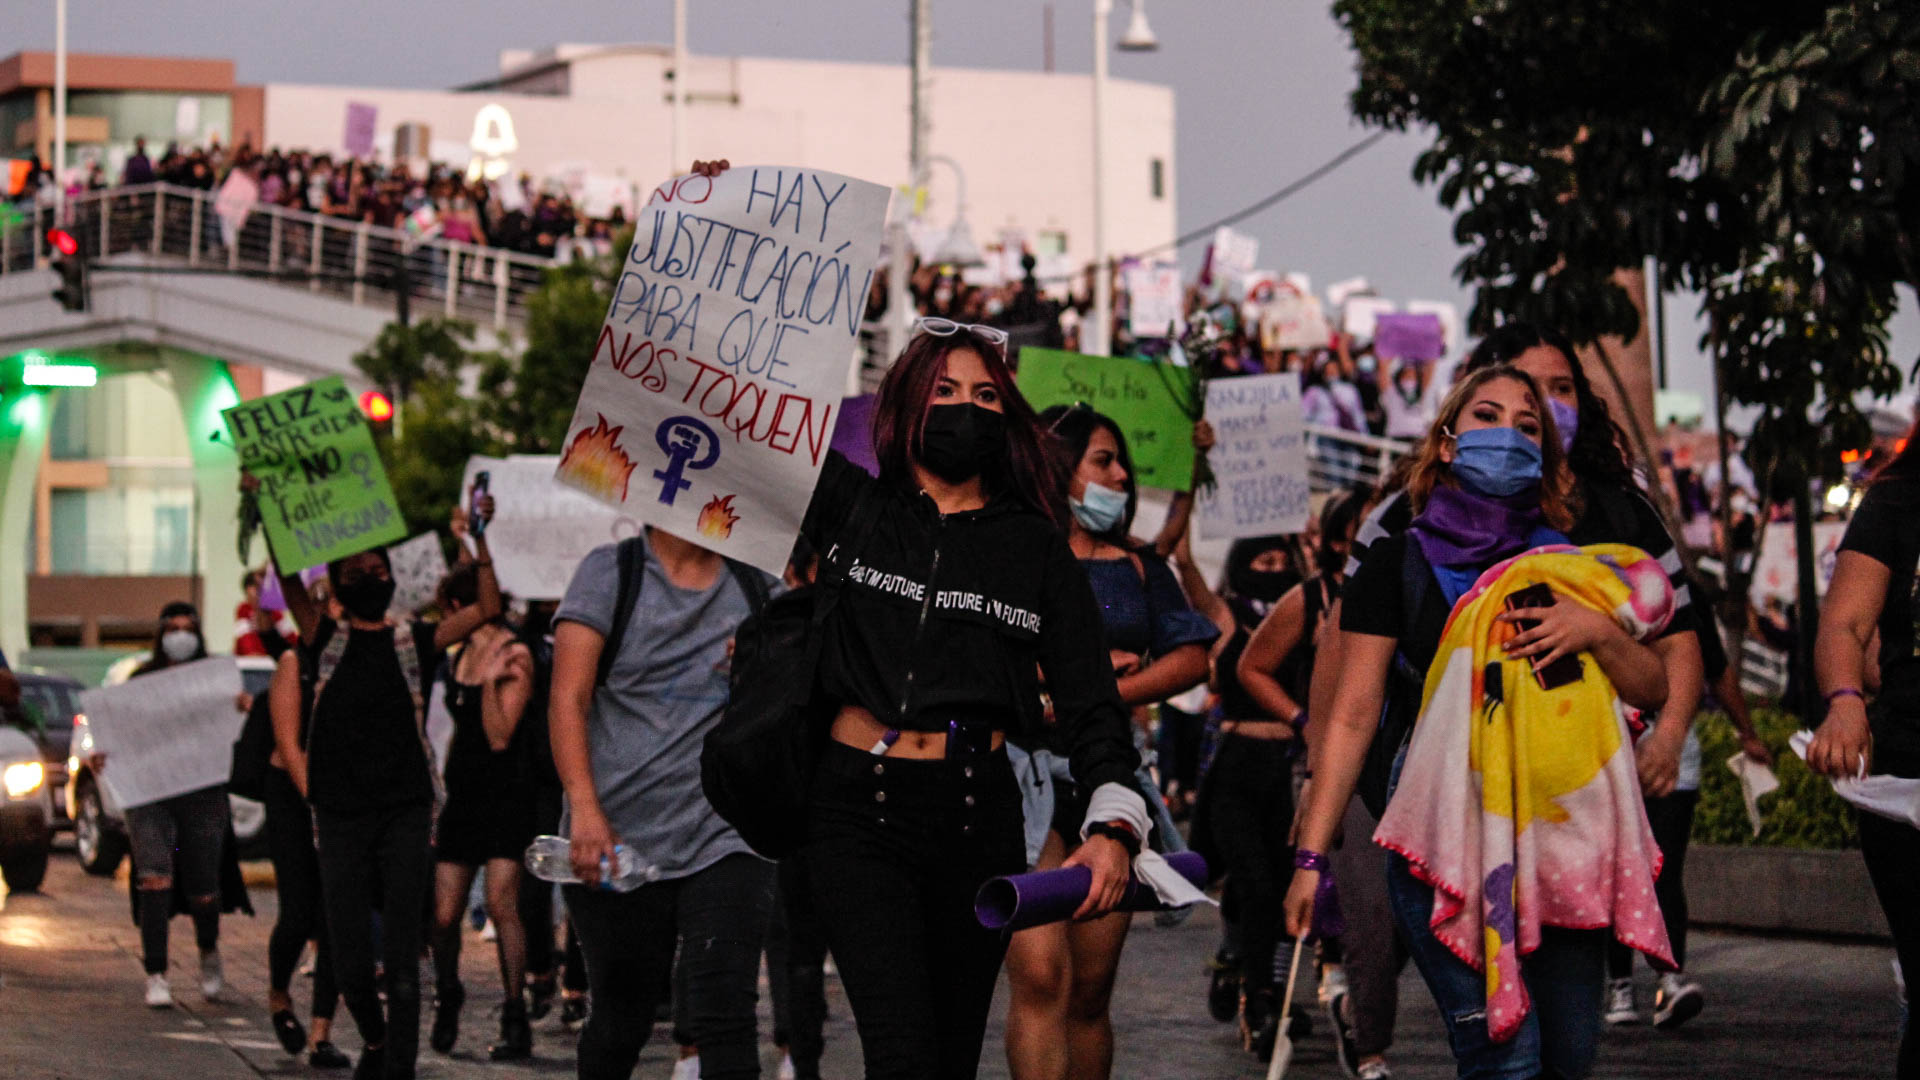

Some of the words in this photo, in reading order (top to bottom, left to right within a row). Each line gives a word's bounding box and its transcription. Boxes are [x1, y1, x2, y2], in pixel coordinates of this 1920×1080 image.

[648, 172, 713, 206] NO
[745, 168, 848, 243] HAY
[630, 209, 873, 338] JUSTIFICACIÓN
[610, 271, 702, 351] PARA
[716, 308, 810, 389] QUE
[231, 388, 320, 440] FELIZ
[591, 324, 678, 394] NOS
[682, 356, 832, 467] TOQUEN
[298, 446, 342, 485] NO
[879, 573, 926, 601] FUTURE
[935, 590, 984, 612] FUTURE
[1002, 604, 1042, 634] FUTURE
